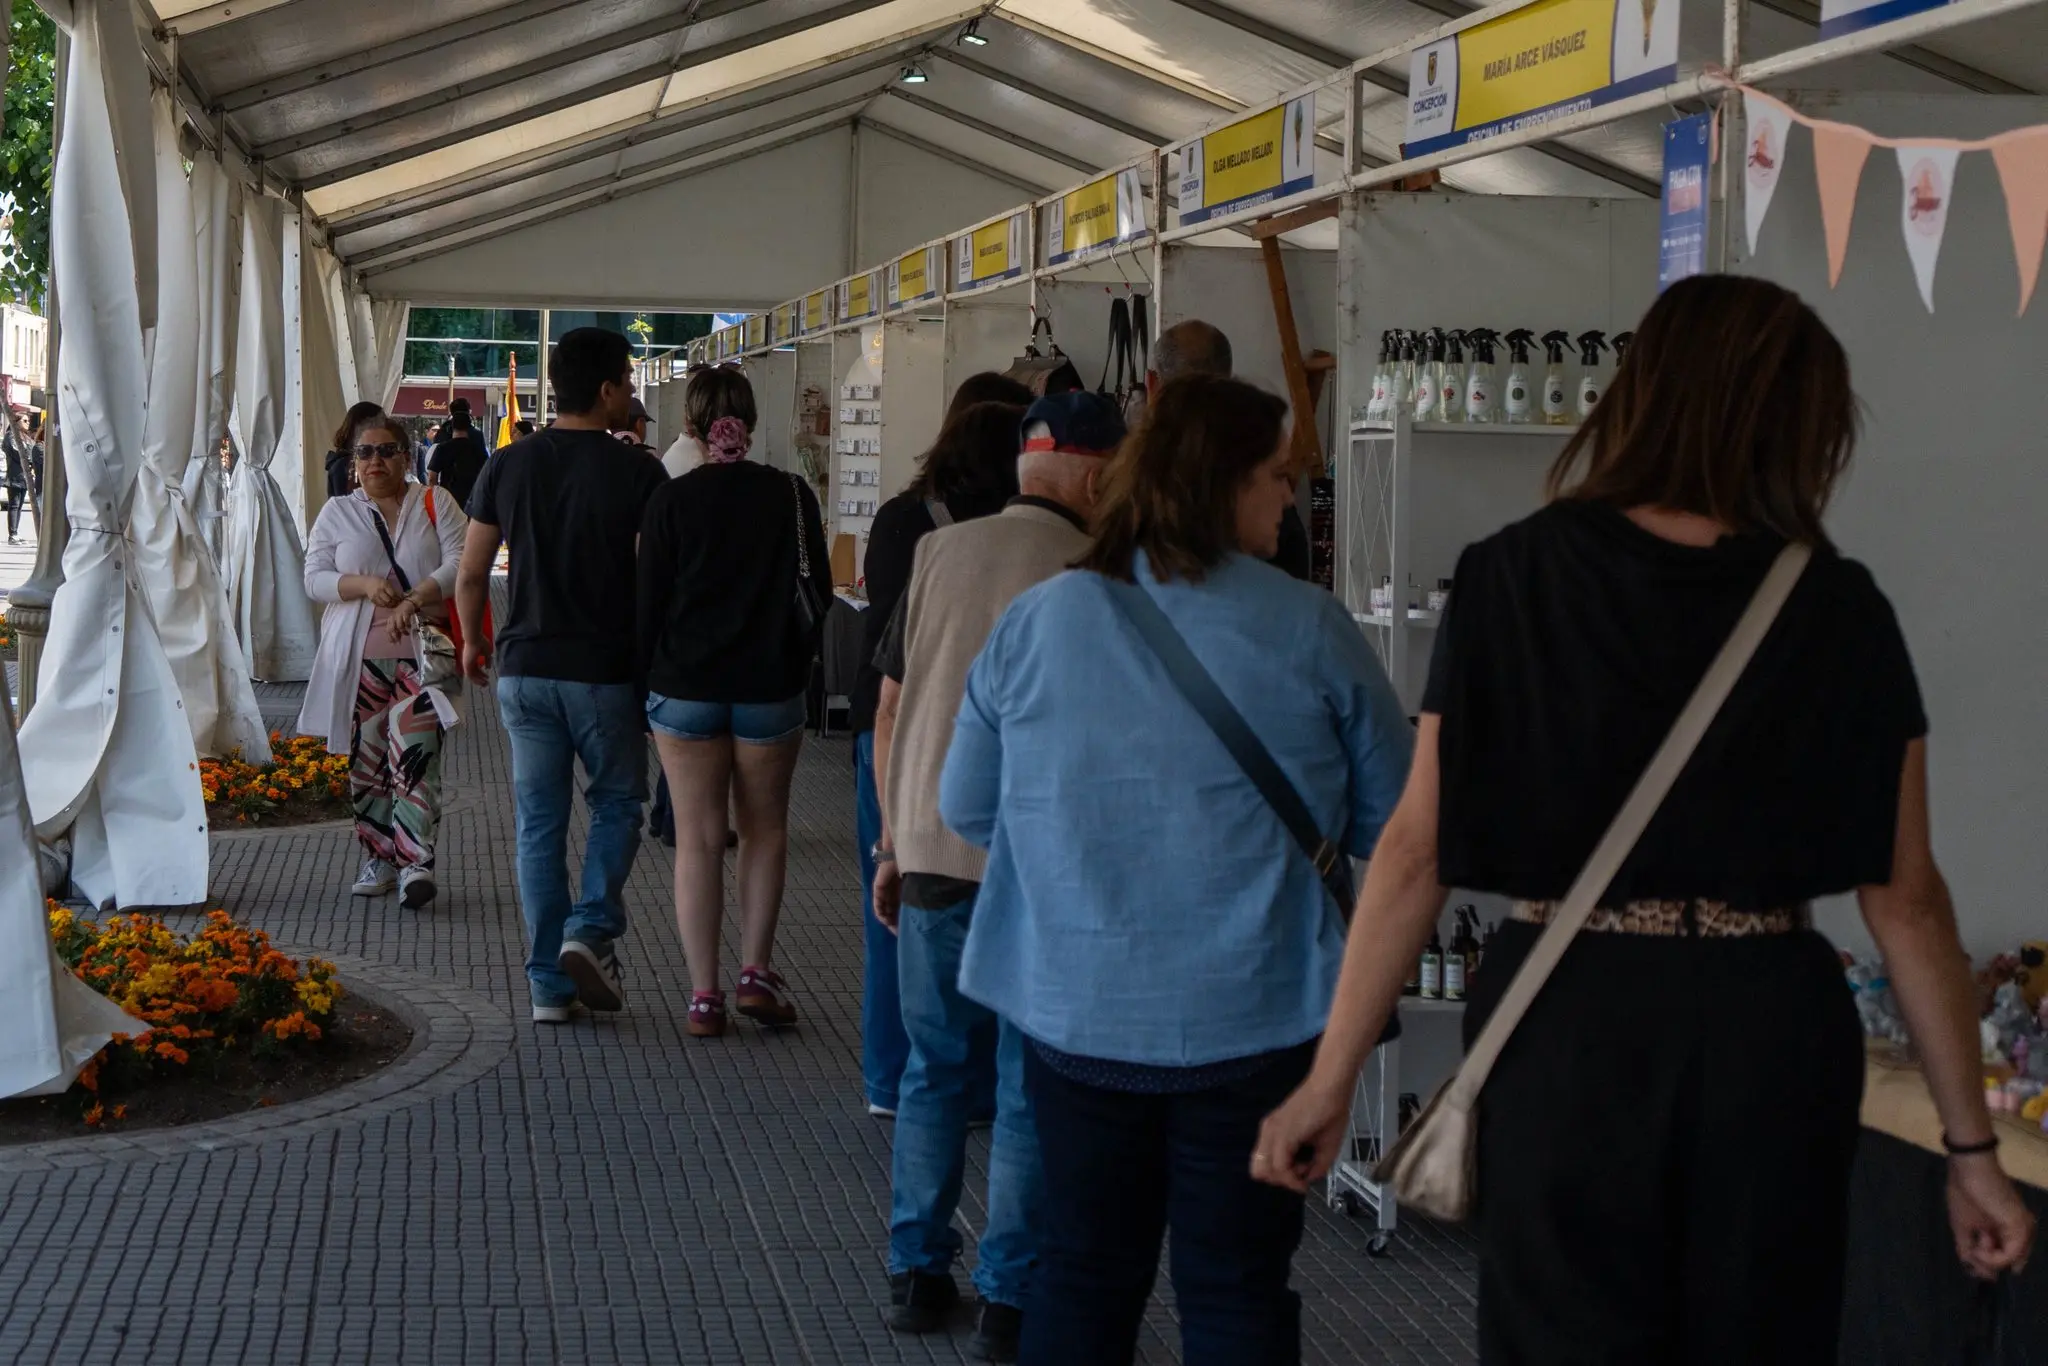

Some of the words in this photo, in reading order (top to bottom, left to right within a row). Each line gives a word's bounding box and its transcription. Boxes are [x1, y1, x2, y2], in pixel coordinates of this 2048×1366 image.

[1483, 53, 1512, 82] MARÍA
[1514, 47, 1539, 72] ARCE
[1541, 29, 1586, 63] VÁSQUEZ
[1213, 157, 1226, 174] OLGA
[1227, 149, 1251, 169] MELLADO
[1251, 141, 1273, 161] MELLADO
